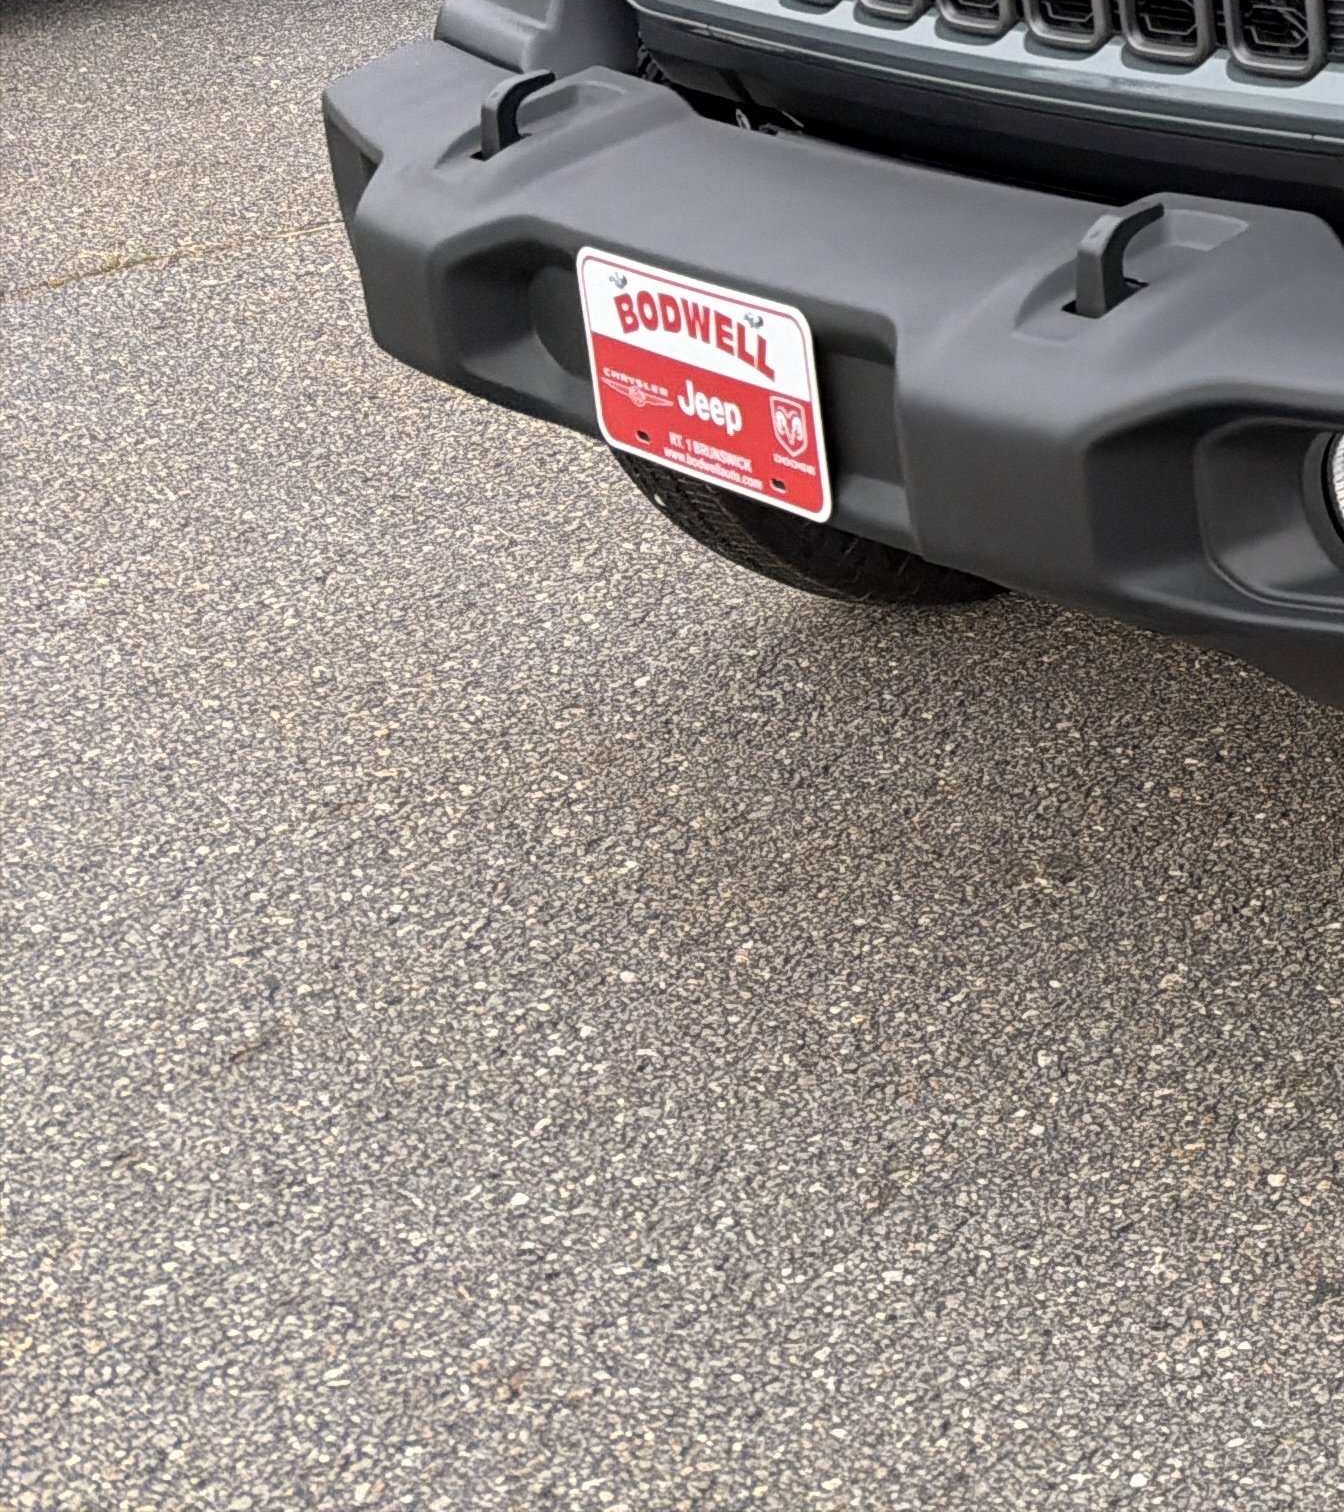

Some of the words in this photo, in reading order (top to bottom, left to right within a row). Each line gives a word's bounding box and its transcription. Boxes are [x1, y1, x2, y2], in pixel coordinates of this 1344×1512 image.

[613, 290, 776, 382] BODWELL
[602, 367, 669, 397] CHRYSLER
[677, 379, 743, 437] Jeep
[772, 452, 816, 477] DODGE
